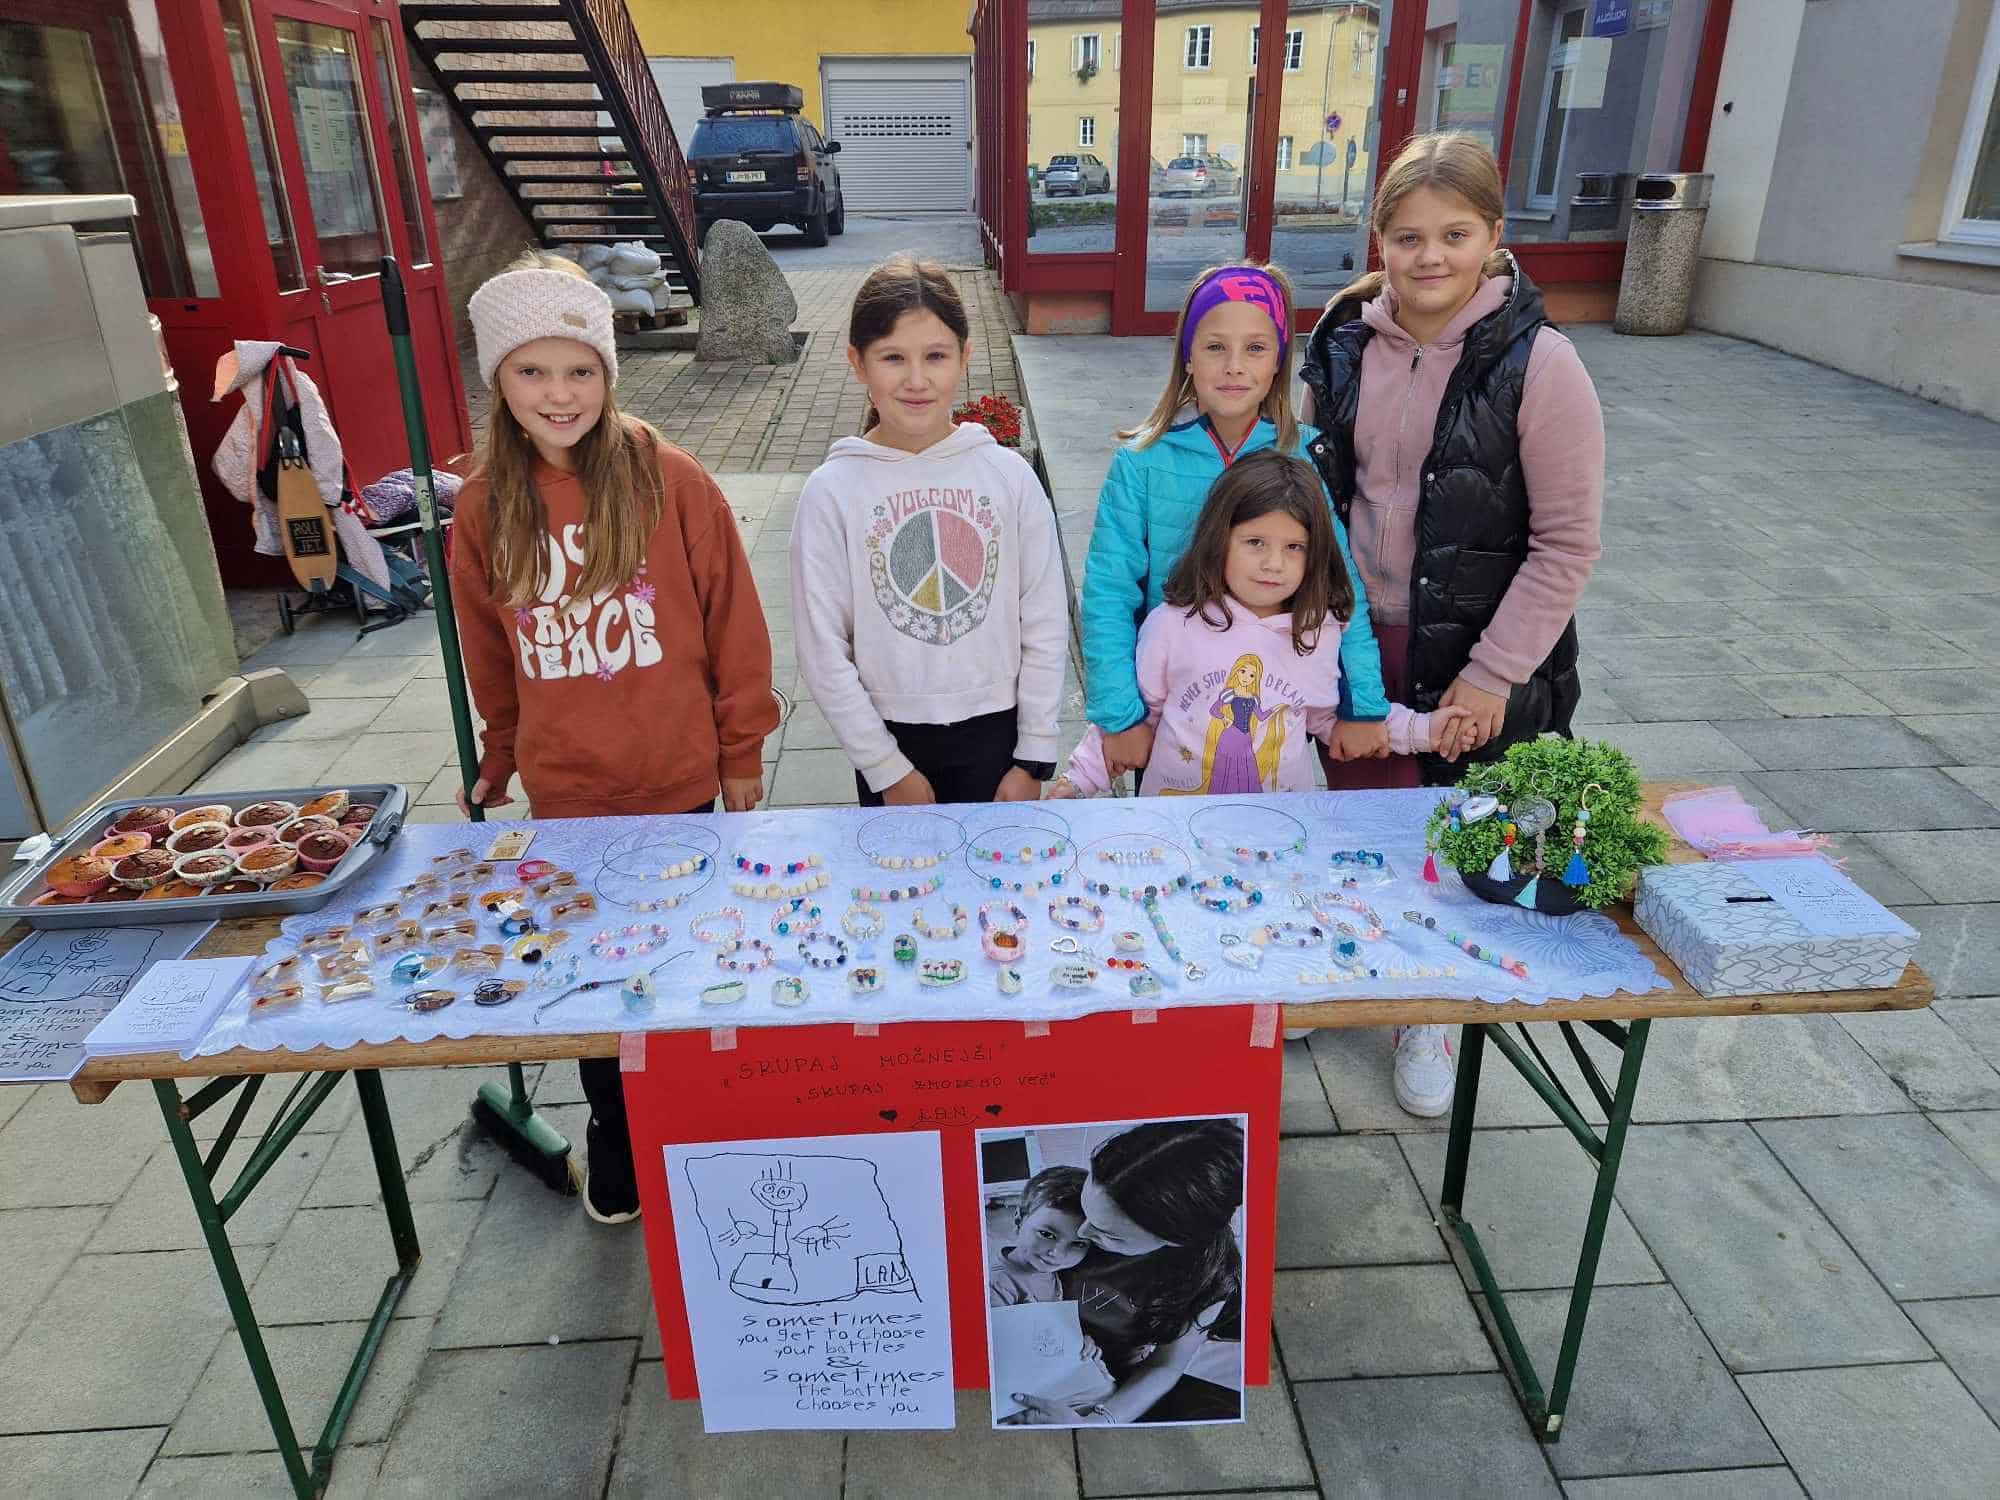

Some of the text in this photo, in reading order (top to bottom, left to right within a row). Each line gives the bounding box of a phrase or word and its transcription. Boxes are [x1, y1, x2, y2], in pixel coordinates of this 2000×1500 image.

[887, 488, 976, 525] VOLCOM
[516, 593, 663, 680] PEACE
[1179, 682, 1202, 712] NEVER
[1203, 669, 1227, 689] STOP
[865, 1261, 907, 1285] LAN
[737, 1333, 769, 1346] you
[777, 1329, 816, 1342] get
[828, 1328, 849, 1341] to
[775, 1340, 906, 1358] your battles
[826, 1355, 871, 1369] &
[797, 1383, 912, 1397] the battle
[887, 1401, 919, 1416] you
